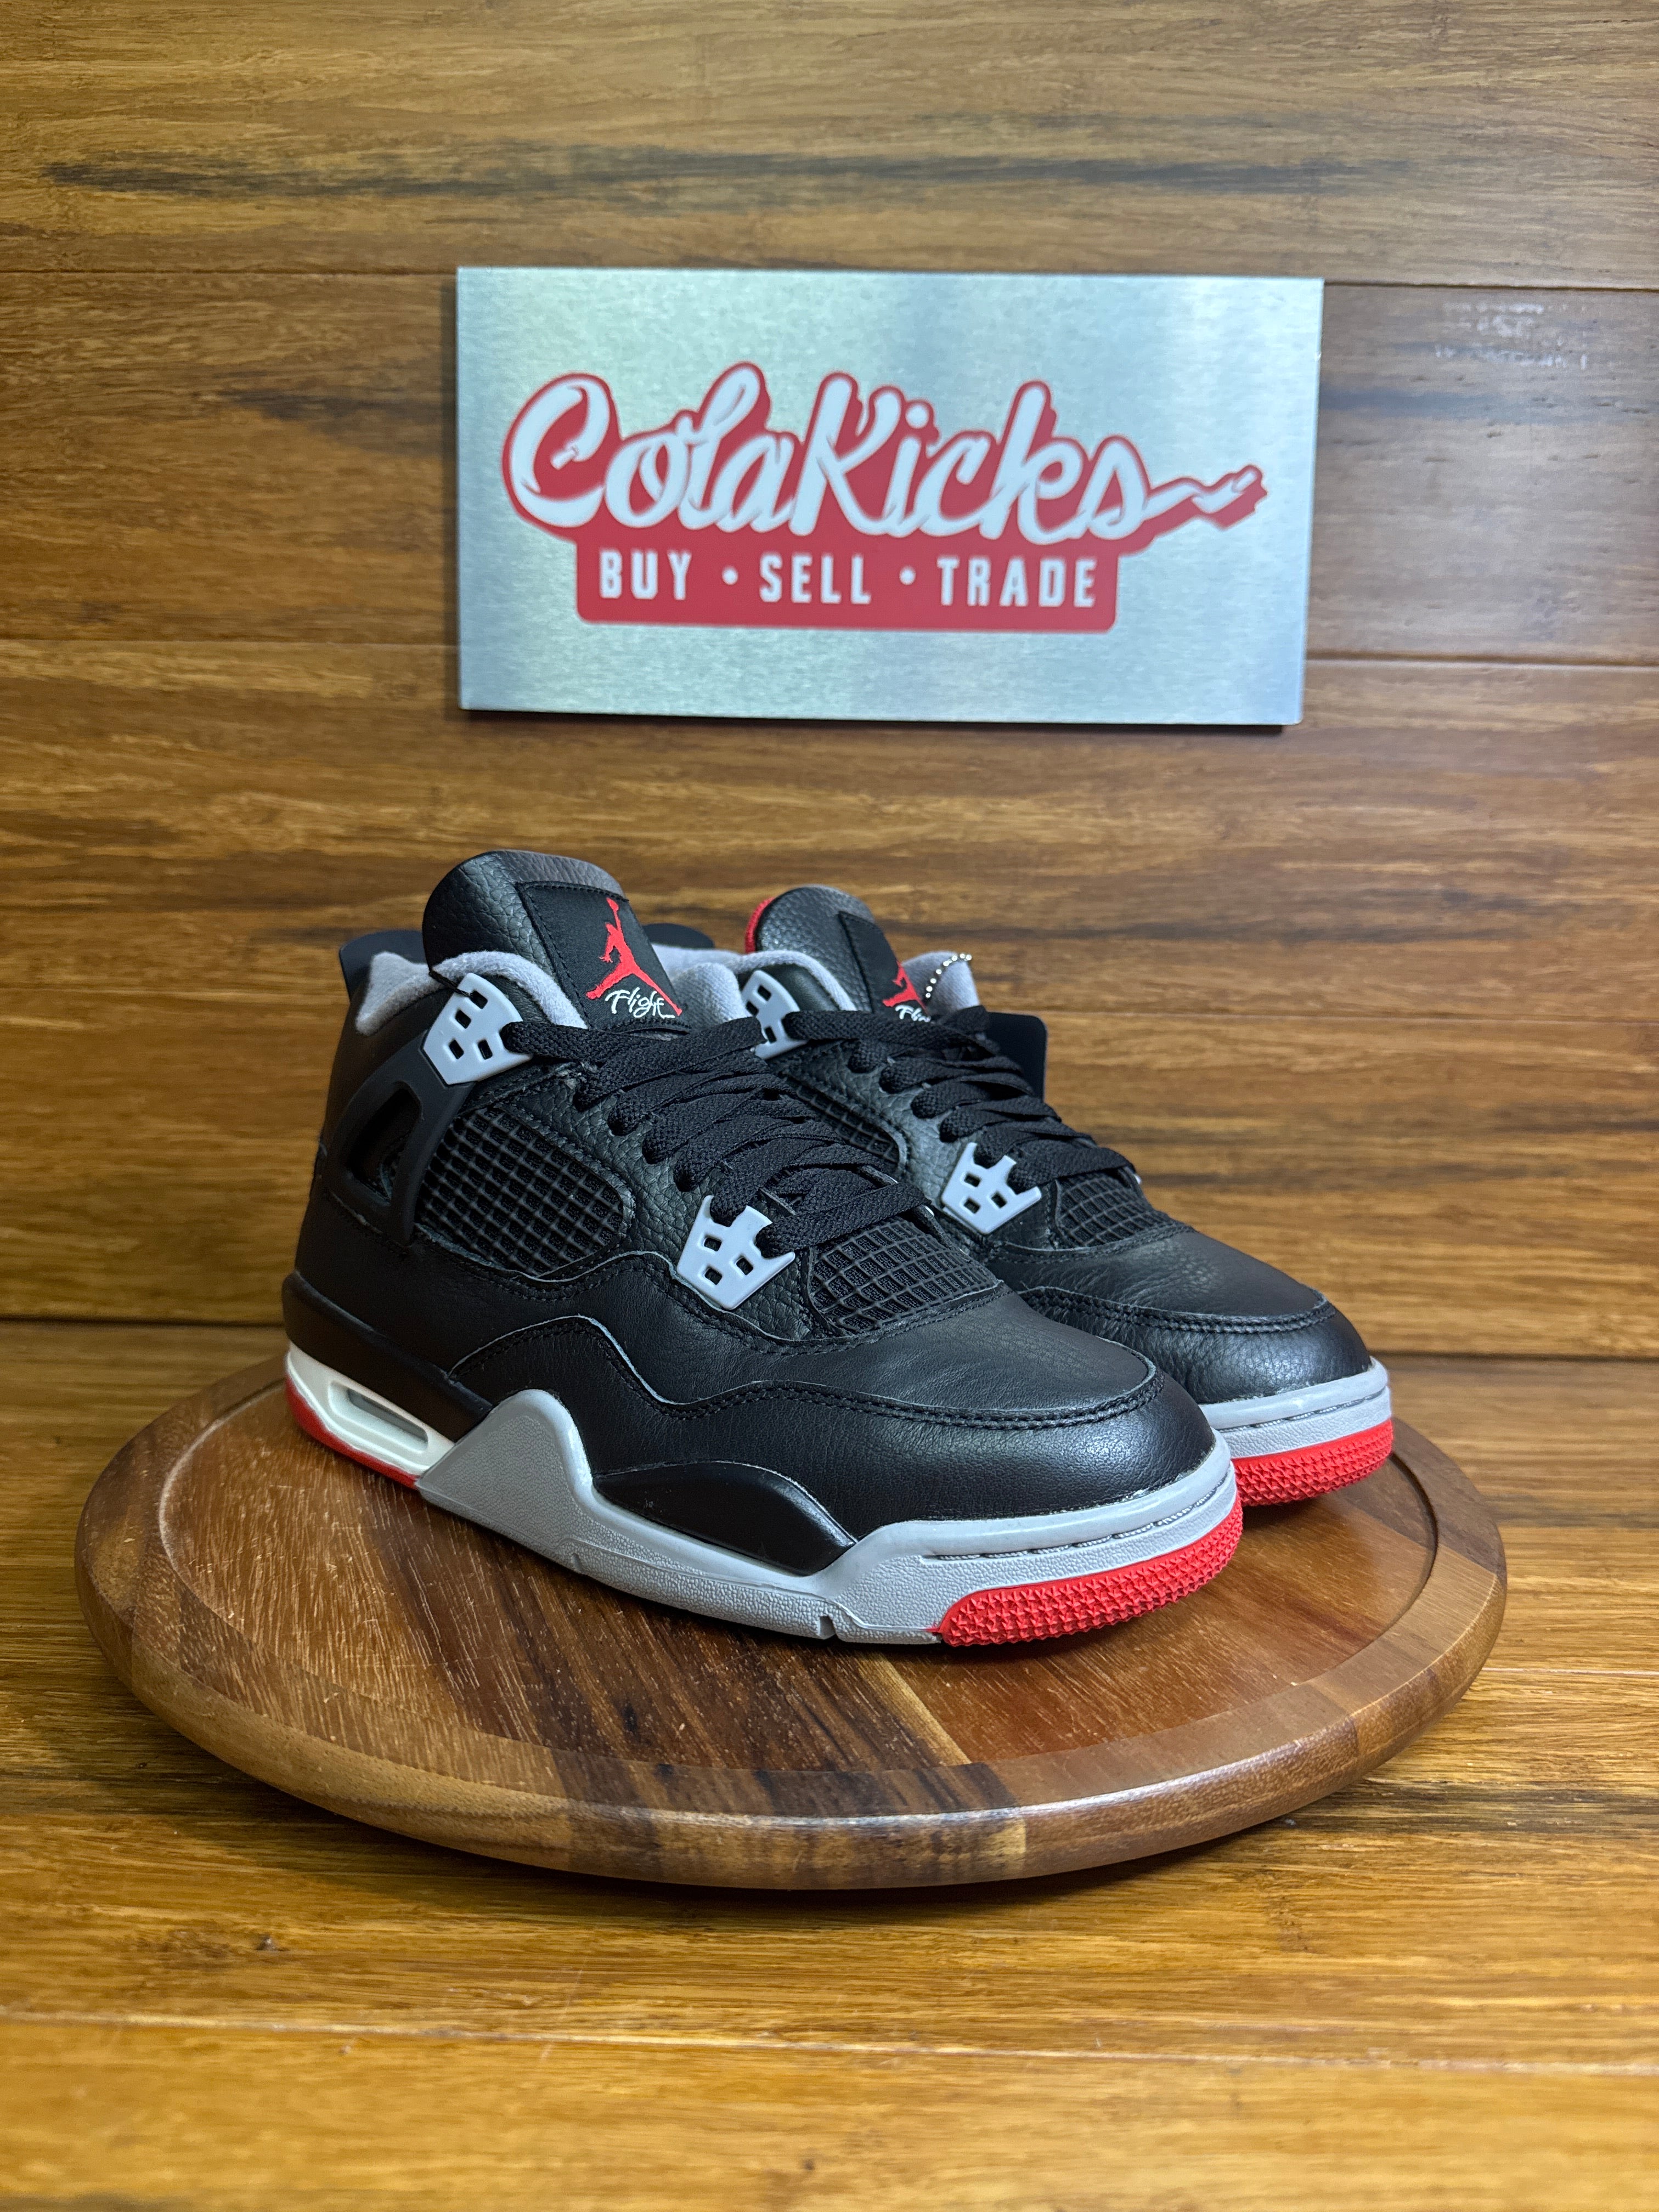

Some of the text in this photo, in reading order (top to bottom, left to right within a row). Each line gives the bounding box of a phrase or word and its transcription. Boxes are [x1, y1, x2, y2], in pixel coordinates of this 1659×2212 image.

[600, 550, 1097, 607] BUY SELL TRADE
[605, 986, 675, 1019] Flight
